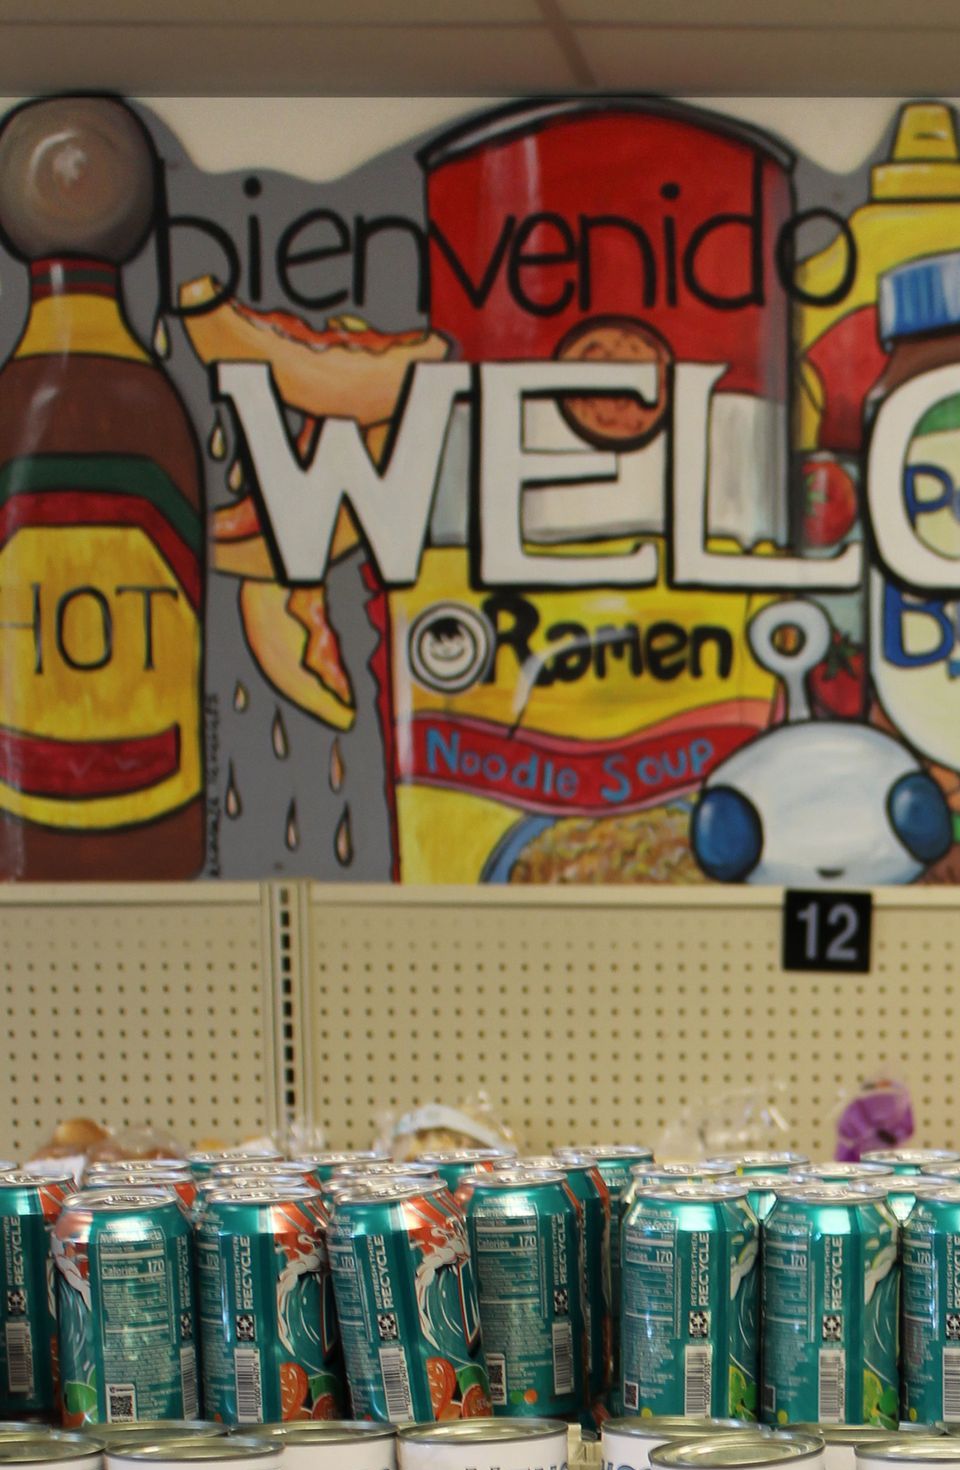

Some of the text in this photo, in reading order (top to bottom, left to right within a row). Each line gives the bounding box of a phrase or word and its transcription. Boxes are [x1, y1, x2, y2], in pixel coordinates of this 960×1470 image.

[153, 152, 858, 317] bienvenido
[480, 589, 734, 687] Ramen
[425, 728, 714, 803] Noodle Soup
[797, 901, 858, 960] 12
[239, 1235, 254, 1310] RECYCLE
[373, 1234, 394, 1309] RECYCLE
[519, 1235, 537, 1248] 170
[557, 1212, 568, 1284] RECYCLE
[656, 1251, 672, 1263] 170
[698, 1232, 710, 1306] RECYCLE
[790, 1254, 806, 1267] 170
[831, 1236, 843, 1310] RECYCLE
